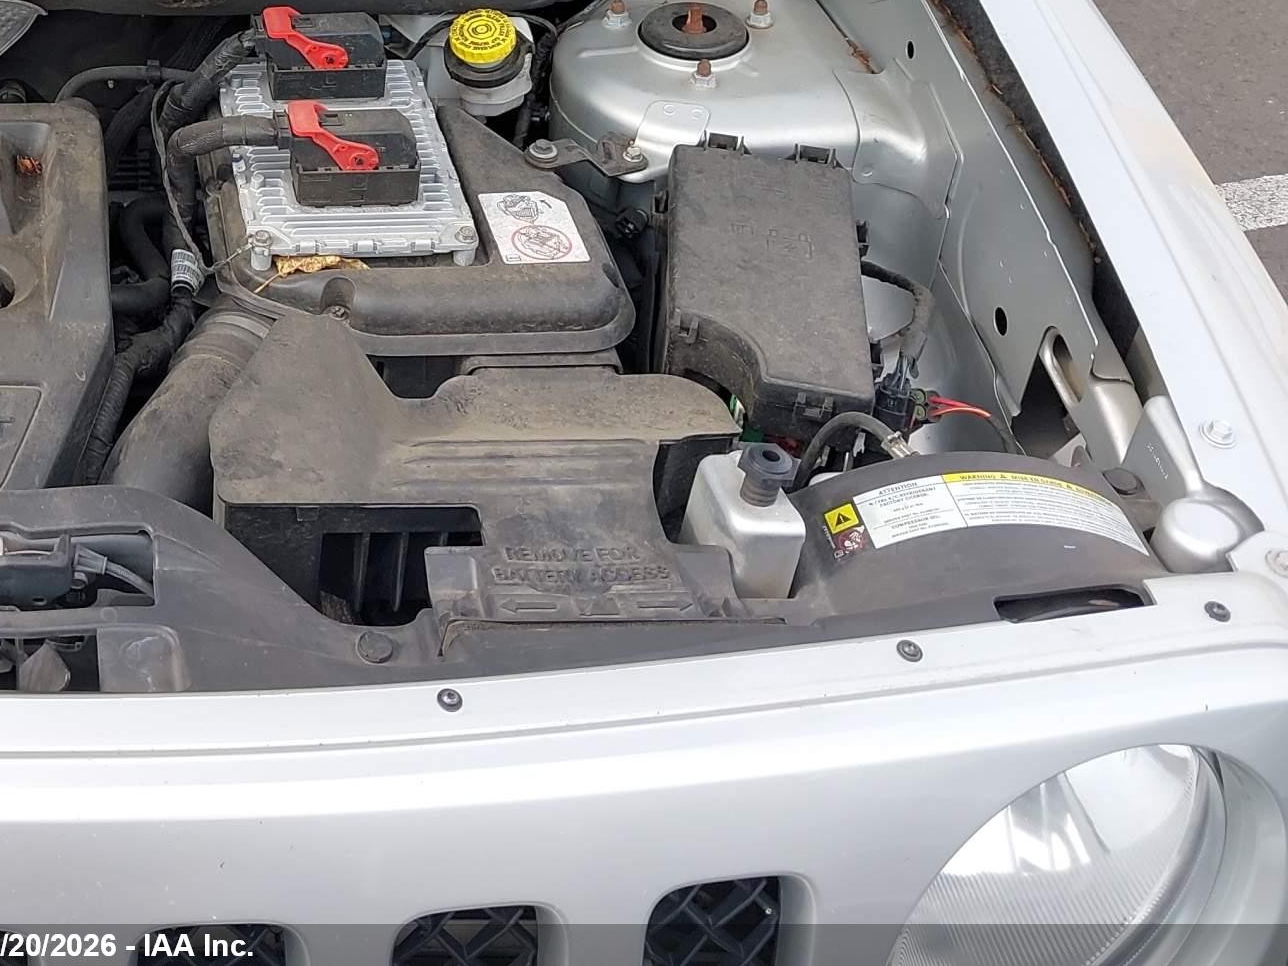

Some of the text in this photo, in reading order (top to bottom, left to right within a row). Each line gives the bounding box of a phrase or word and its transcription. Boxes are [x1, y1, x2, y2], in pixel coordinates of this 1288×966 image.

[878, 482, 918, 494] ATTENTION
[504, 546, 641, 562] REMOVE FOR
[491, 565, 672, 584] BATTERY ACCESS
